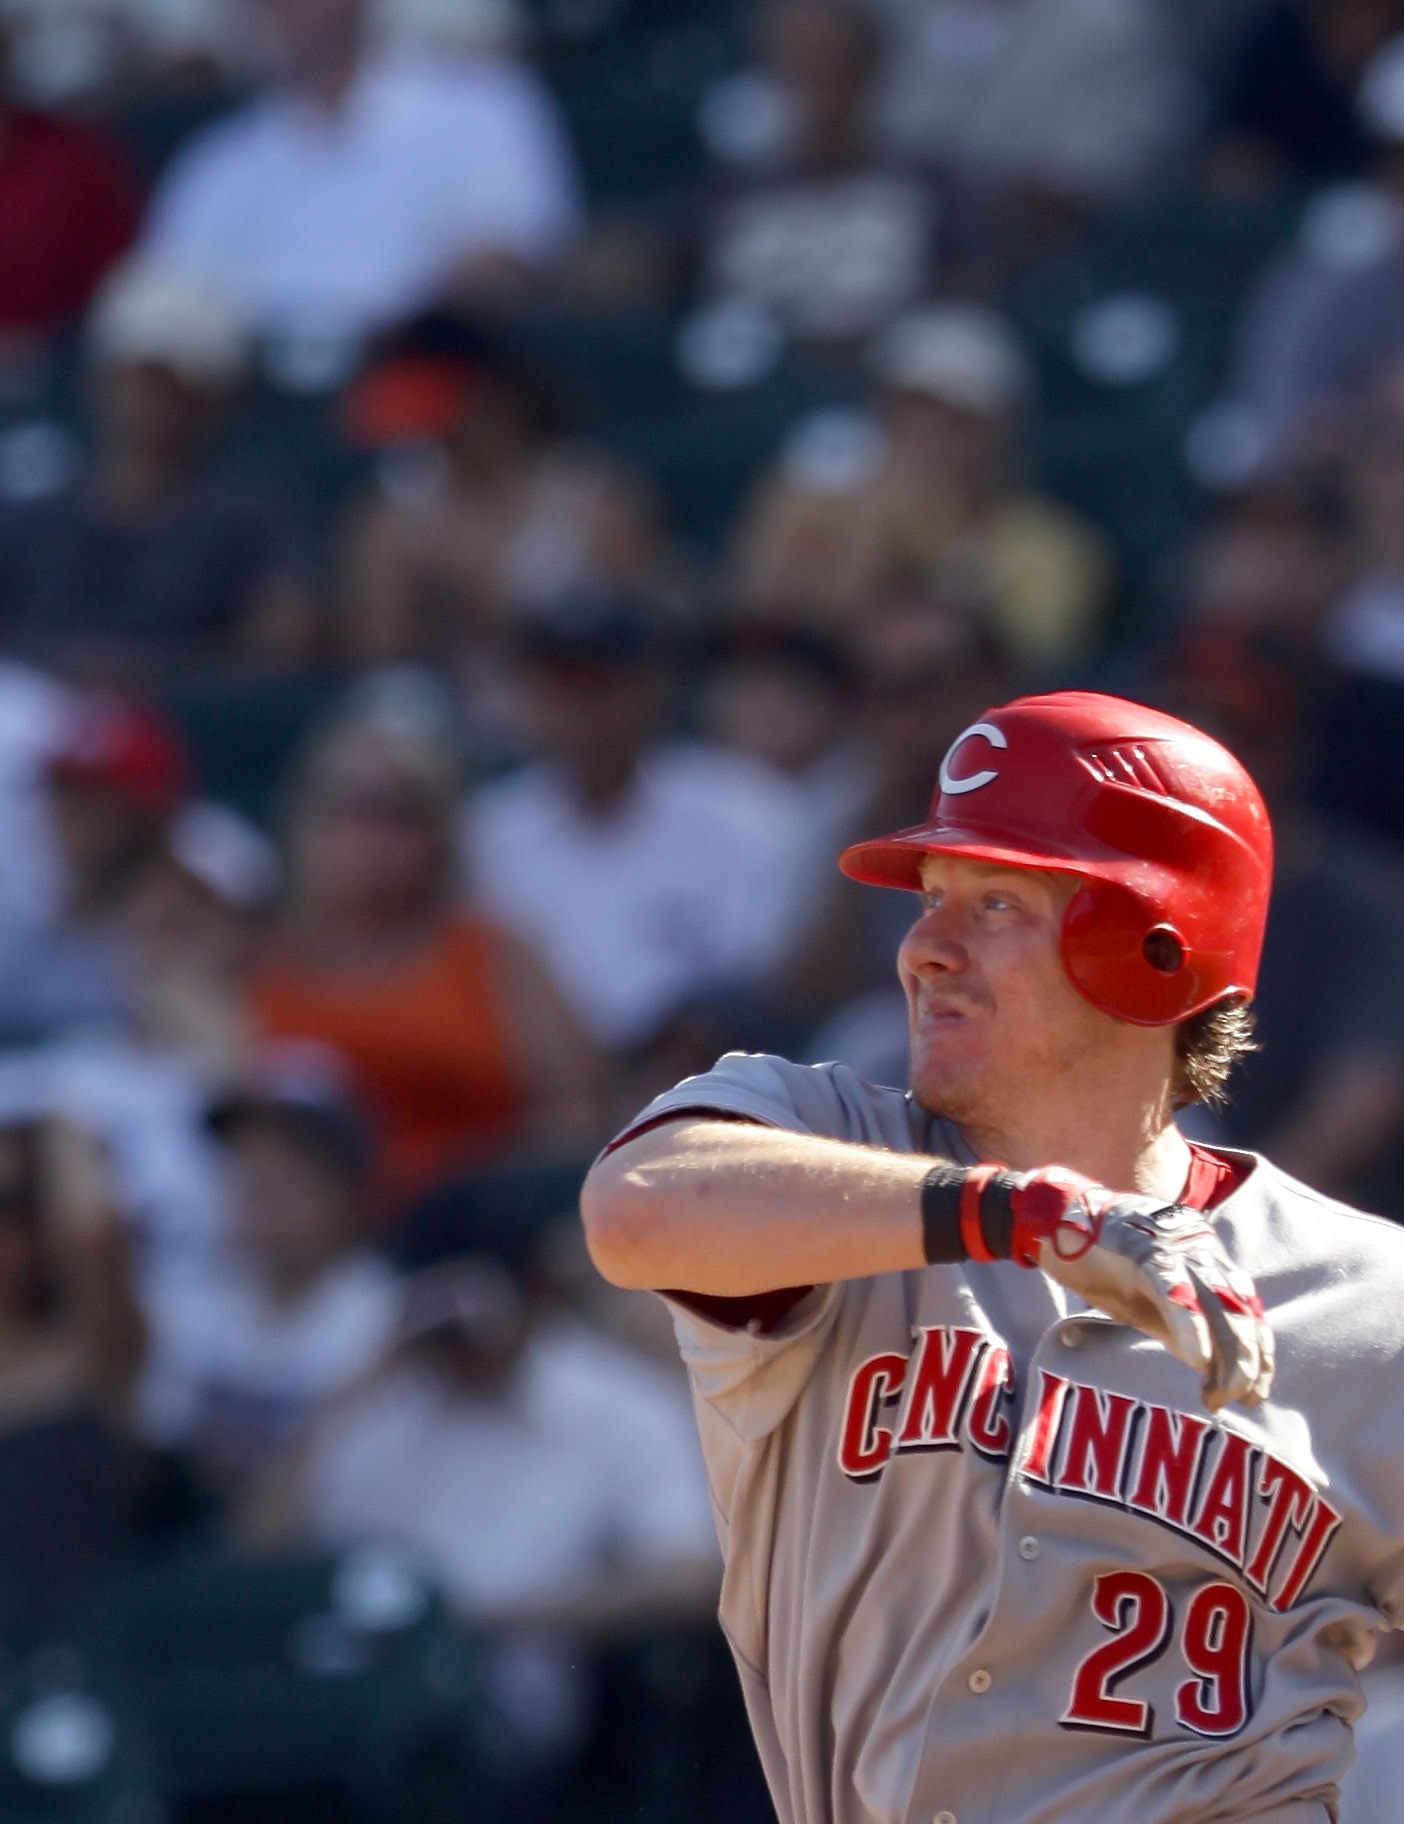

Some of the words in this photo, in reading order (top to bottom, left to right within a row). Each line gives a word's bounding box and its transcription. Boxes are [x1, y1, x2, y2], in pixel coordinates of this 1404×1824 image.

[939, 723, 1007, 795] C
[837, 1325, 1343, 1615] CNCINNATI
[1058, 1569, 1253, 1742] 29
